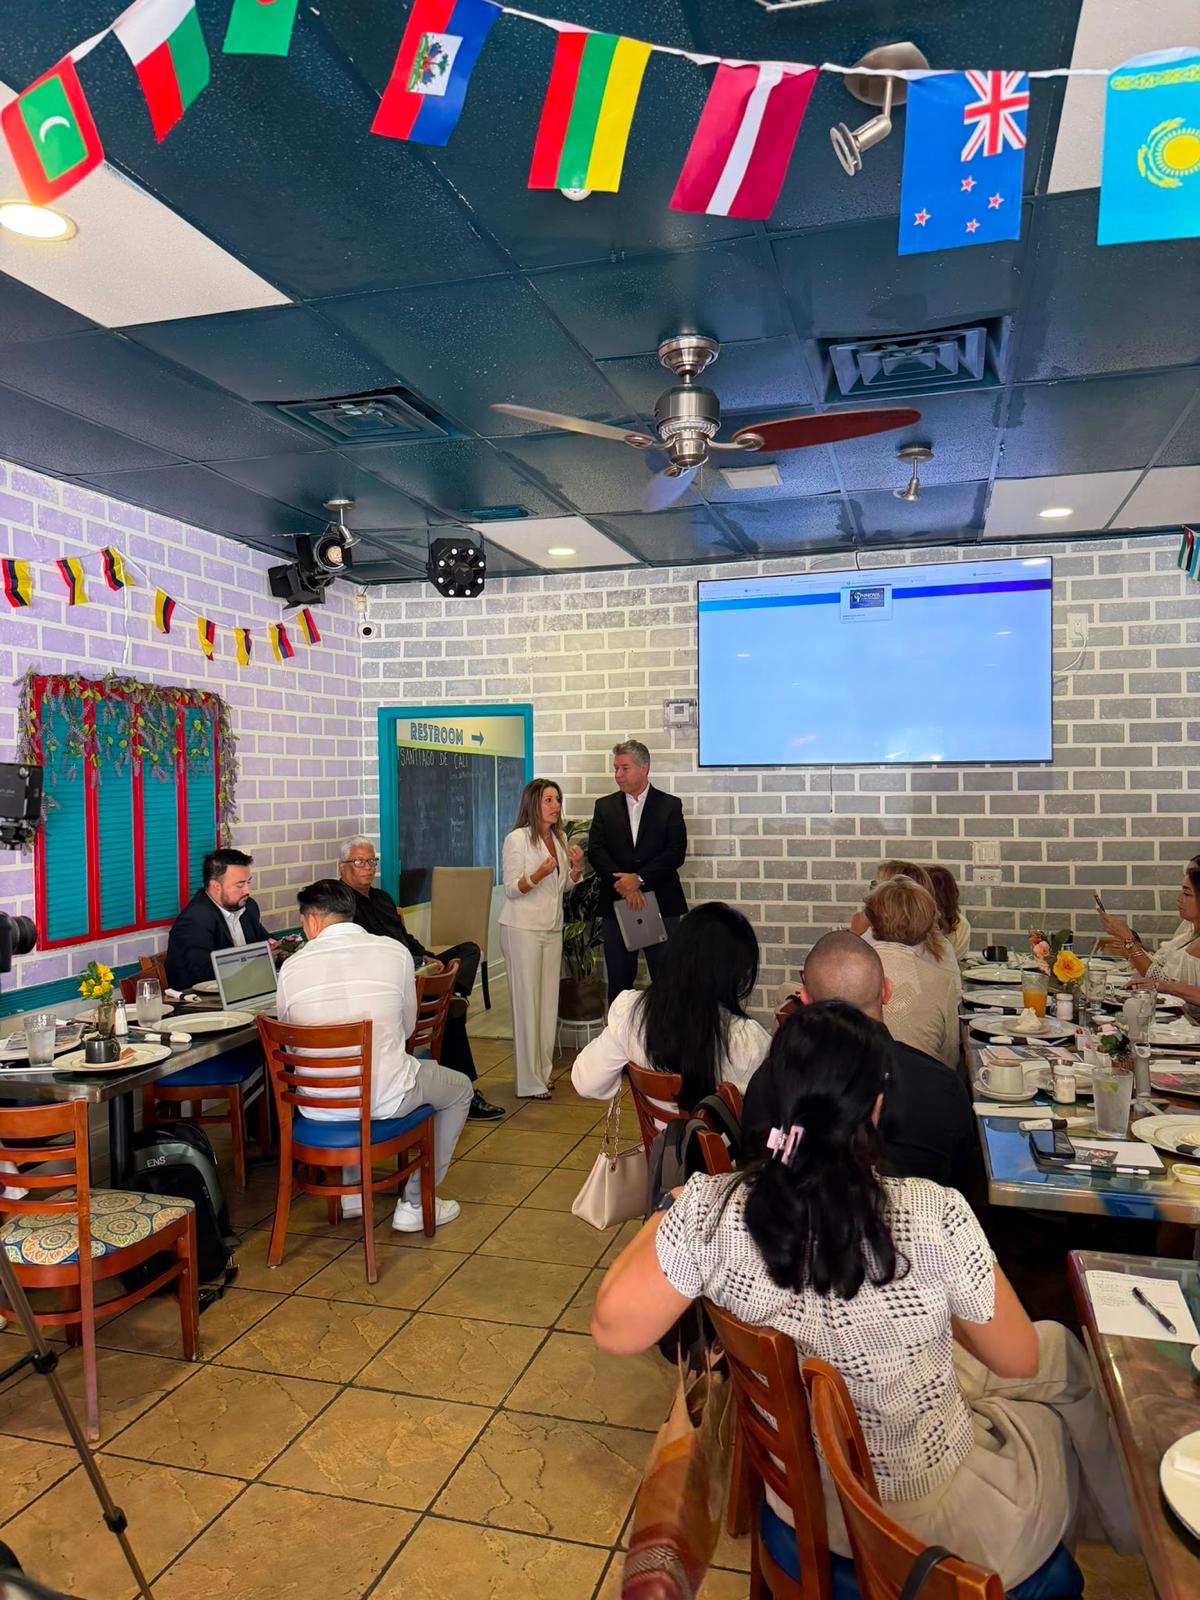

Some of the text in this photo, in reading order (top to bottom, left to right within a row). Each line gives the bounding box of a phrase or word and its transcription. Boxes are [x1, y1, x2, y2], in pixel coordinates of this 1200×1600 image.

[410, 722, 464, 745] RESTROOM
[400, 748, 434, 767] SANTIAGO
[439, 752, 448, 766] DE
